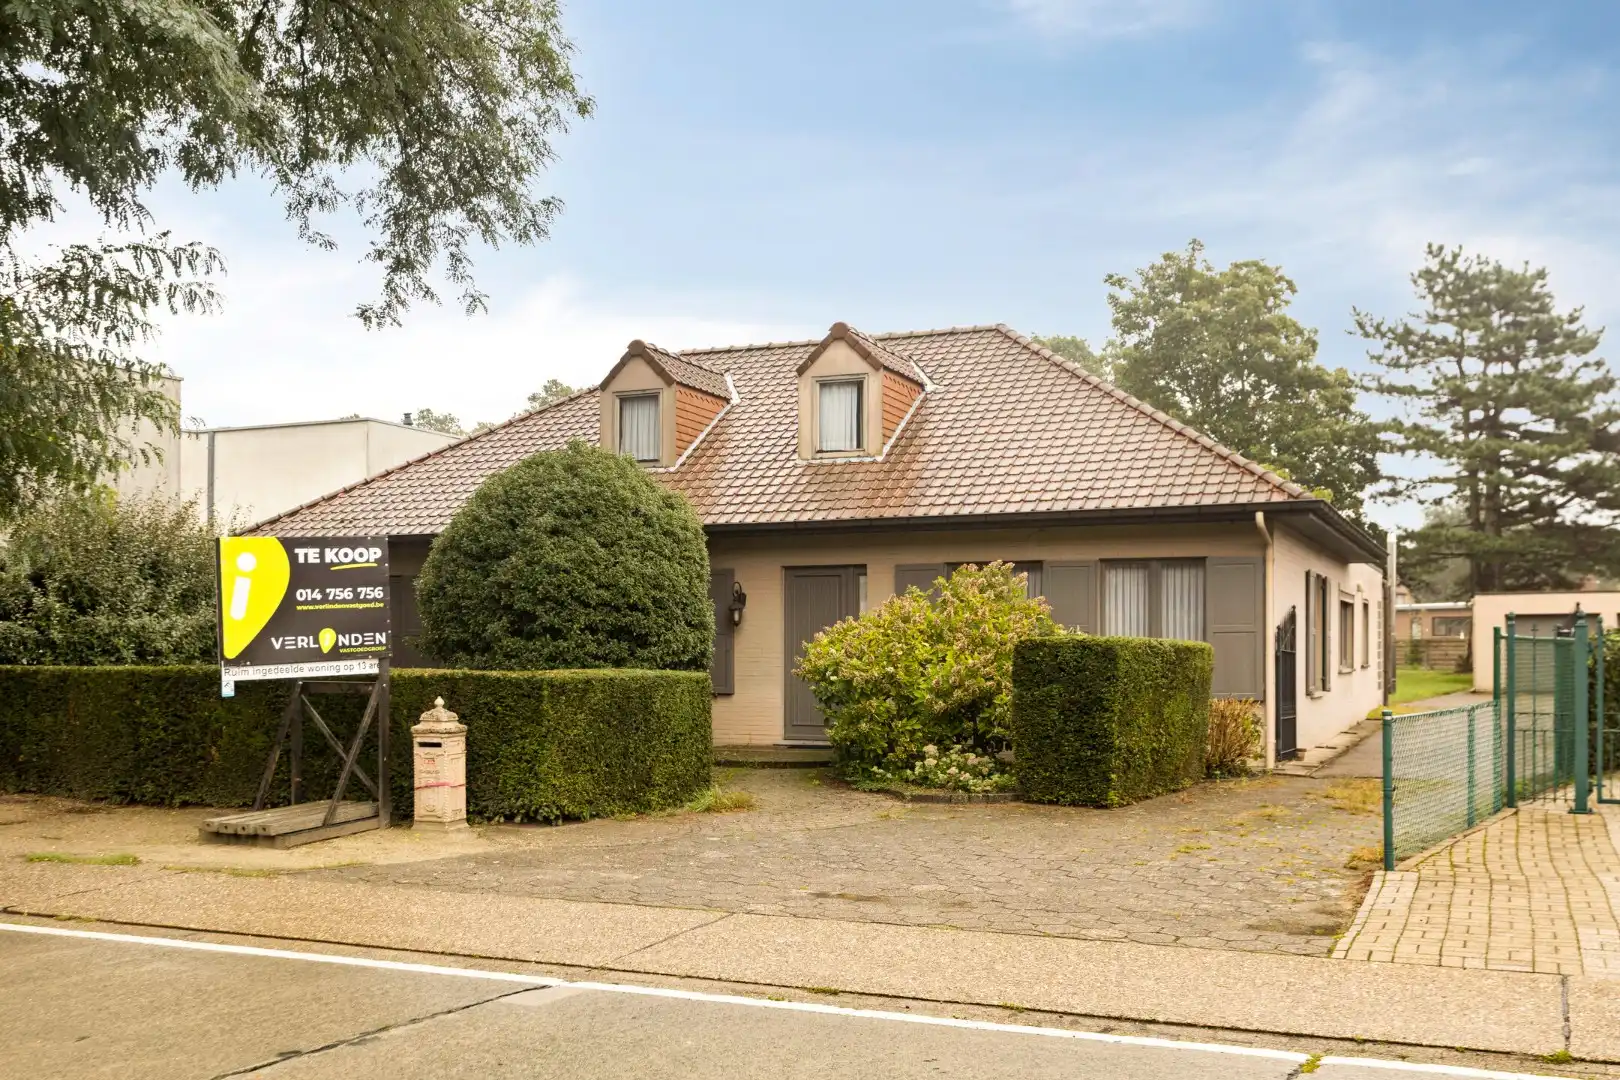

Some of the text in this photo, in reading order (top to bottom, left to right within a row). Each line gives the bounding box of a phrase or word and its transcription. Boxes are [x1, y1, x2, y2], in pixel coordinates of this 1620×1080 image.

[294, 547, 382, 564] TE KOOP
[295, 586, 384, 601] 014 756 756
[296, 602, 384, 611] www.verlindenvastgoed.be
[224, 667, 250, 677] Ruim
[252, 664, 305, 677] ingedeelde
[307, 663, 341, 673] woning
[343, 663, 355, 672] op
[357, 661, 367, 670] 13
